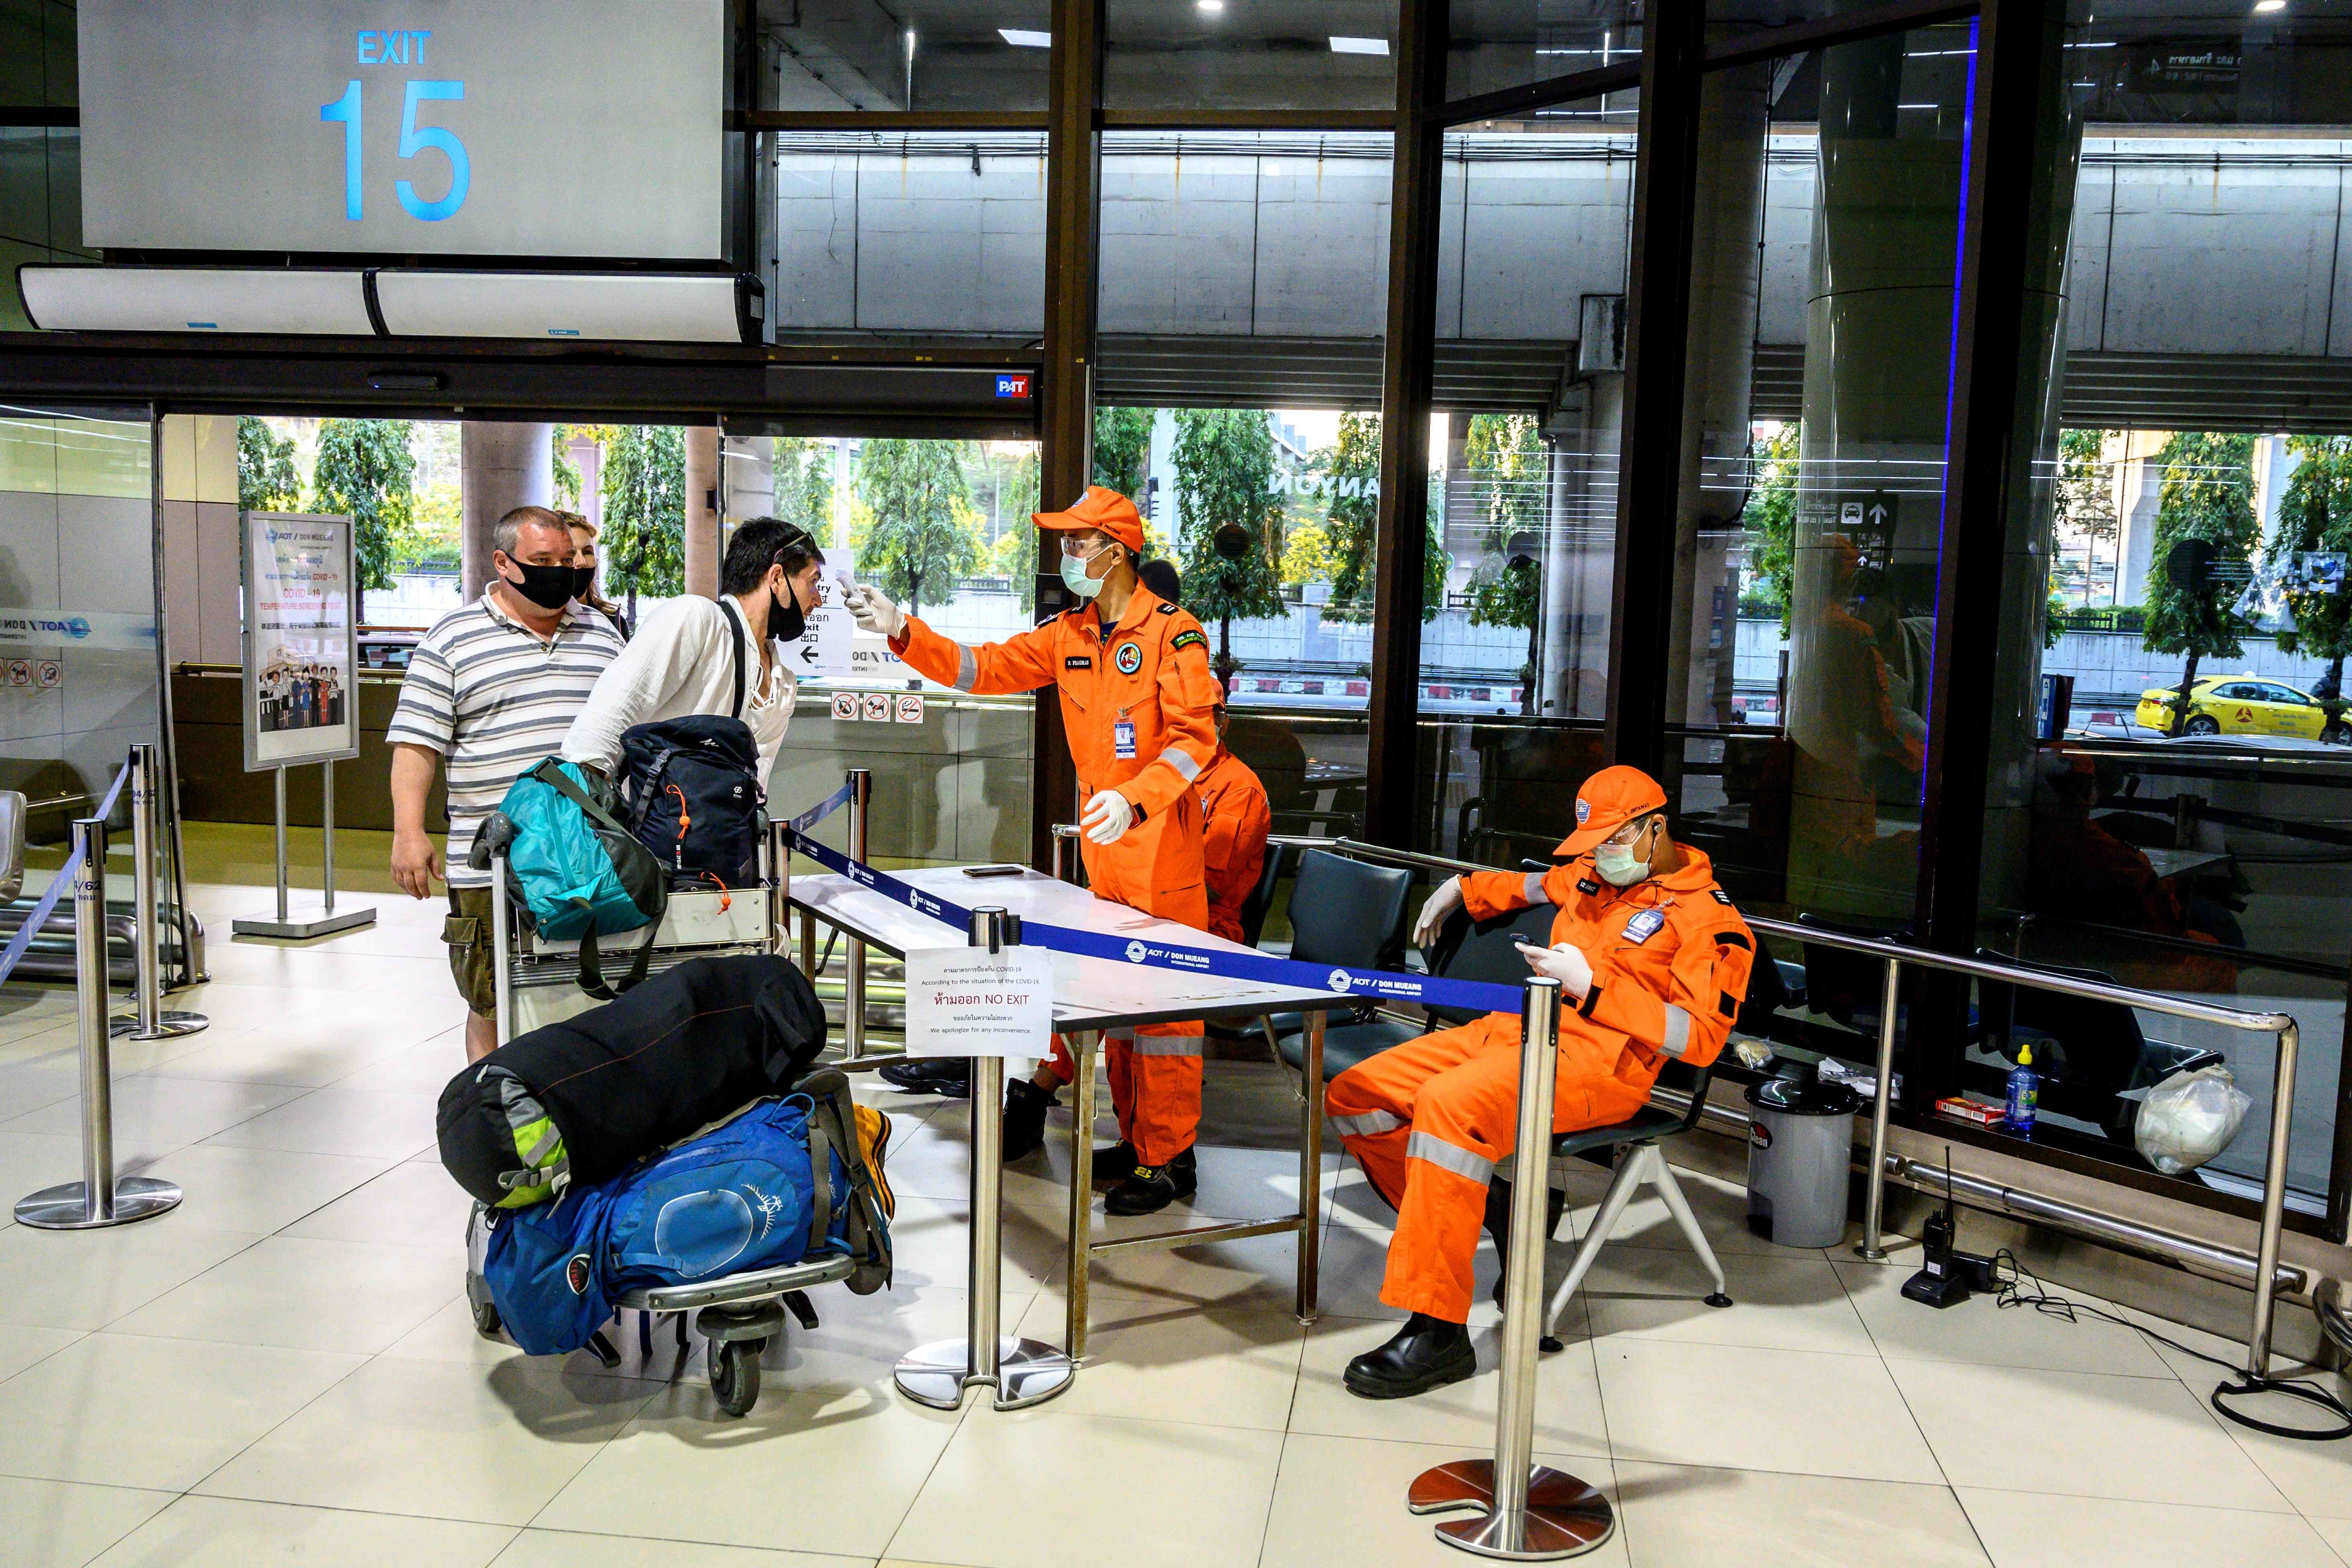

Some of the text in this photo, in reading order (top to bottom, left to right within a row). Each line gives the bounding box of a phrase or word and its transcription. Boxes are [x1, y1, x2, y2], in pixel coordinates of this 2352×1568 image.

[357, 30, 432, 65] EXIT
[320, 79, 470, 222] 15
[284, 588, 305, 598] COVID
[313, 589, 320, 598] 19
[800, 633, 818, 643] 出口
[1185, 955, 1210, 964] MUEANG
[1352, 978, 1370, 986] AOT
[1394, 982, 1422, 991] MUEANG
[934, 992, 1029, 1005] ห้ามออก NO EXIT
[1750, 1126, 1767, 1148] Clean
